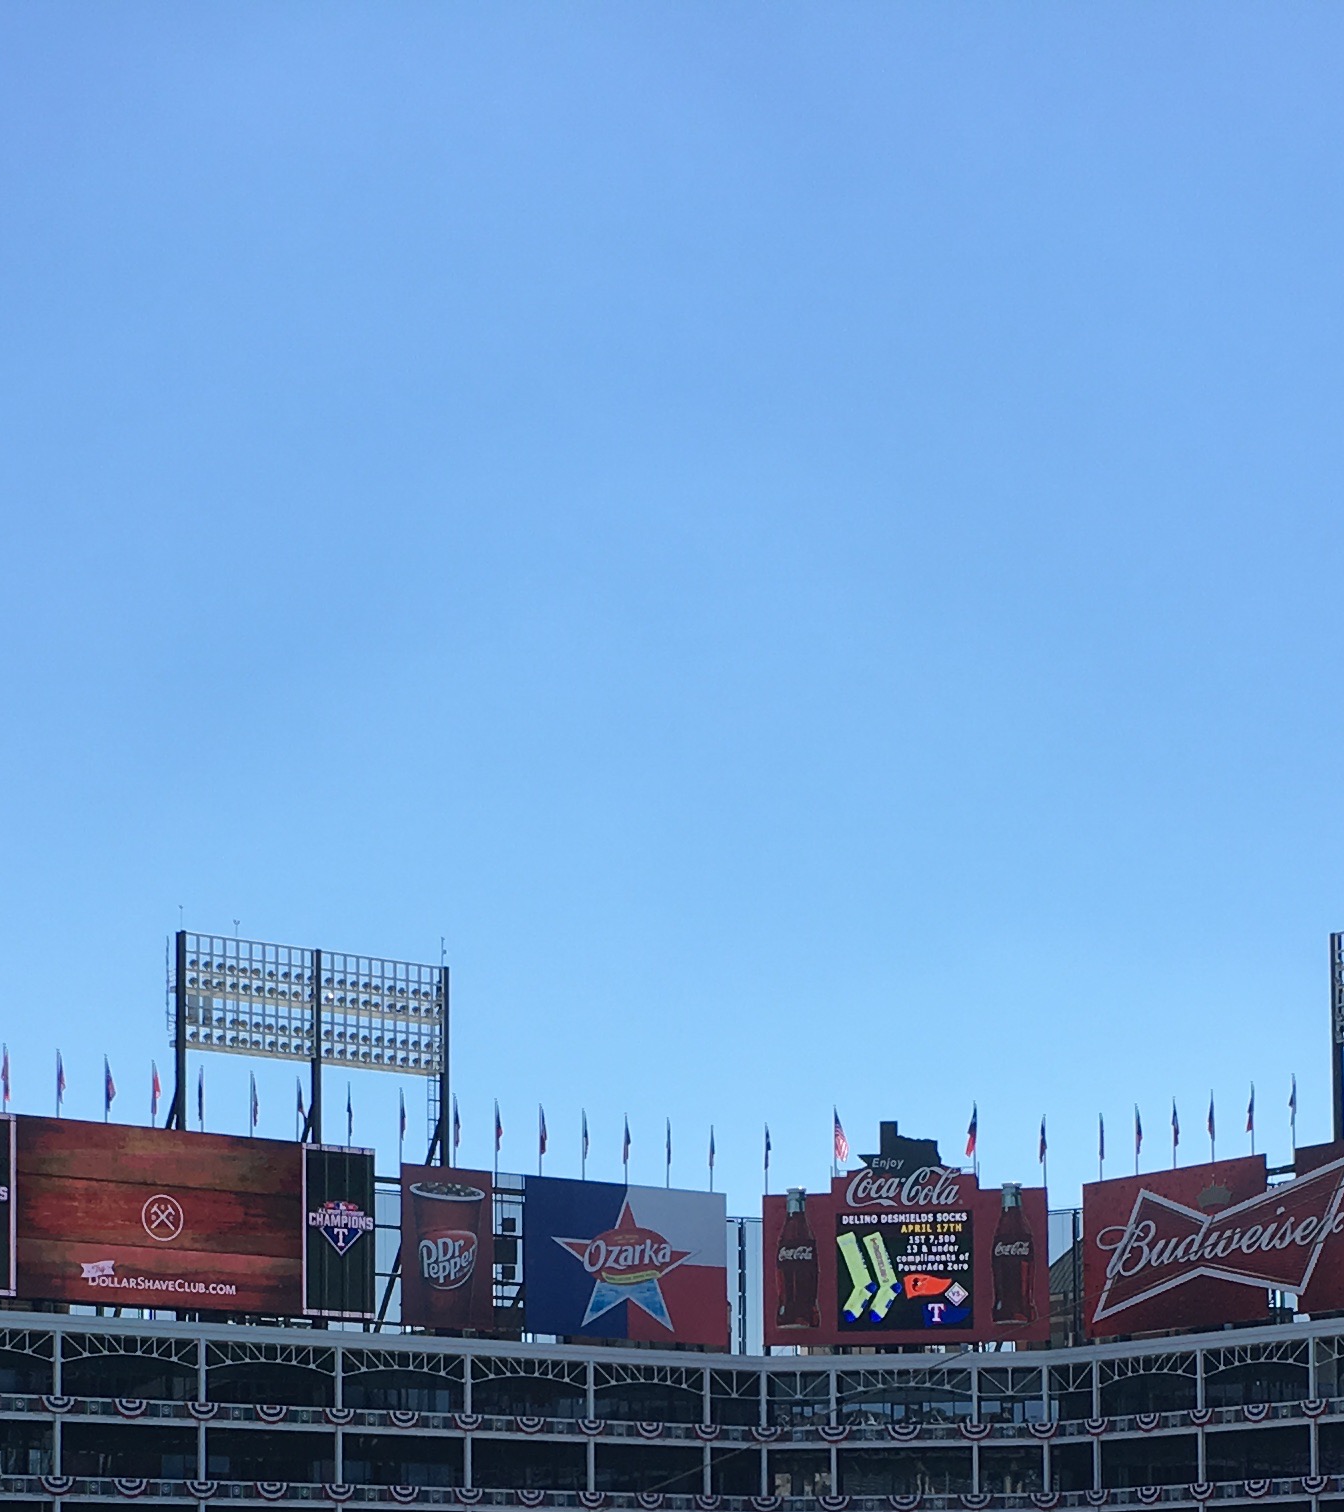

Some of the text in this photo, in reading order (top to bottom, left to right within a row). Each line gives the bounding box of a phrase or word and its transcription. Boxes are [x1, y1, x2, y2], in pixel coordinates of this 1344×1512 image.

[870, 1157, 905, 1170] Enjoy
[308, 1211, 374, 1231] CHAMPIONS
[841, 1212, 968, 1225] DELINO DESHIELDS SOCKS
[900, 1223, 963, 1234] APRIL 17TH
[437, 1237, 465, 1262] Dr
[931, 1243, 959, 1253] under
[419, 1238, 477, 1284] Pepper
[582, 1238, 673, 1273] Ozarka
[896, 1253, 957, 1264] compliments
